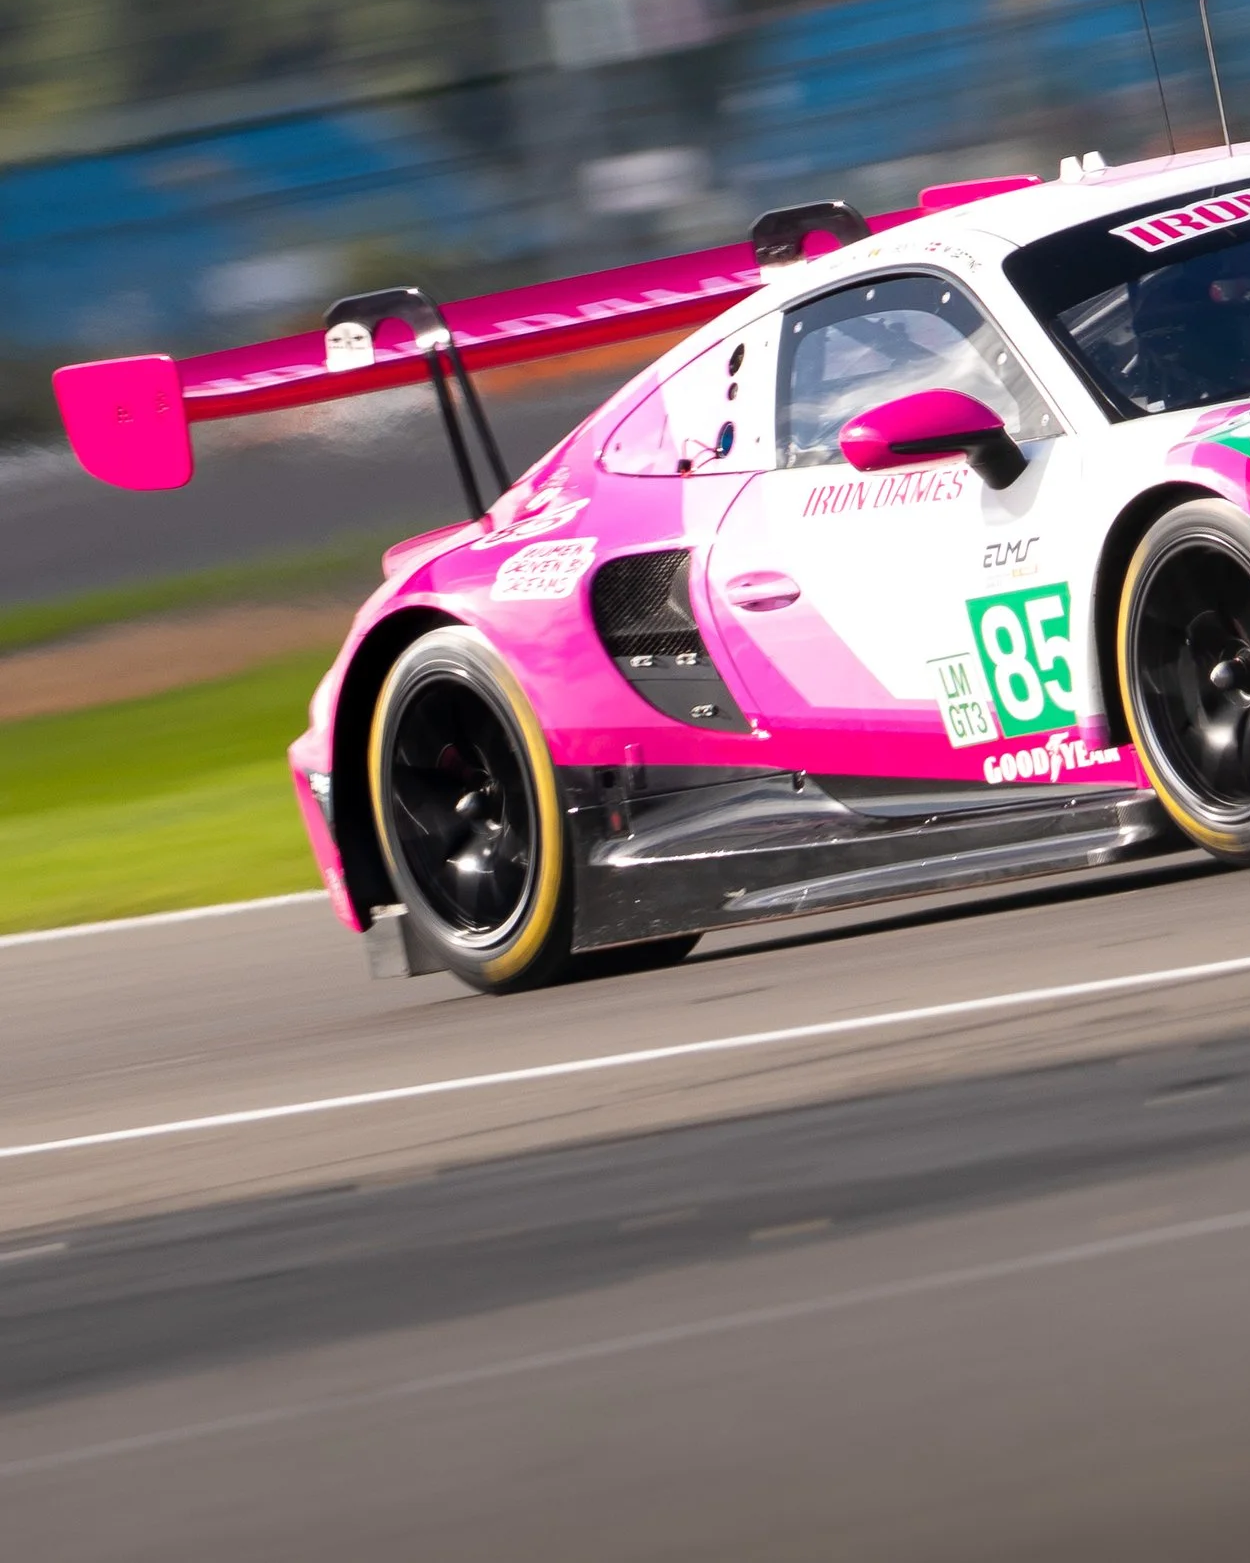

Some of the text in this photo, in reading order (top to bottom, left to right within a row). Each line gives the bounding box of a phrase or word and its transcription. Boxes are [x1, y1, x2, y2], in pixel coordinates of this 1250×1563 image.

[803, 469, 968, 517] IRON DAMES
[981, 595, 1078, 721] 85
[939, 663, 972, 699] LM
[948, 701, 989, 739] GT3
